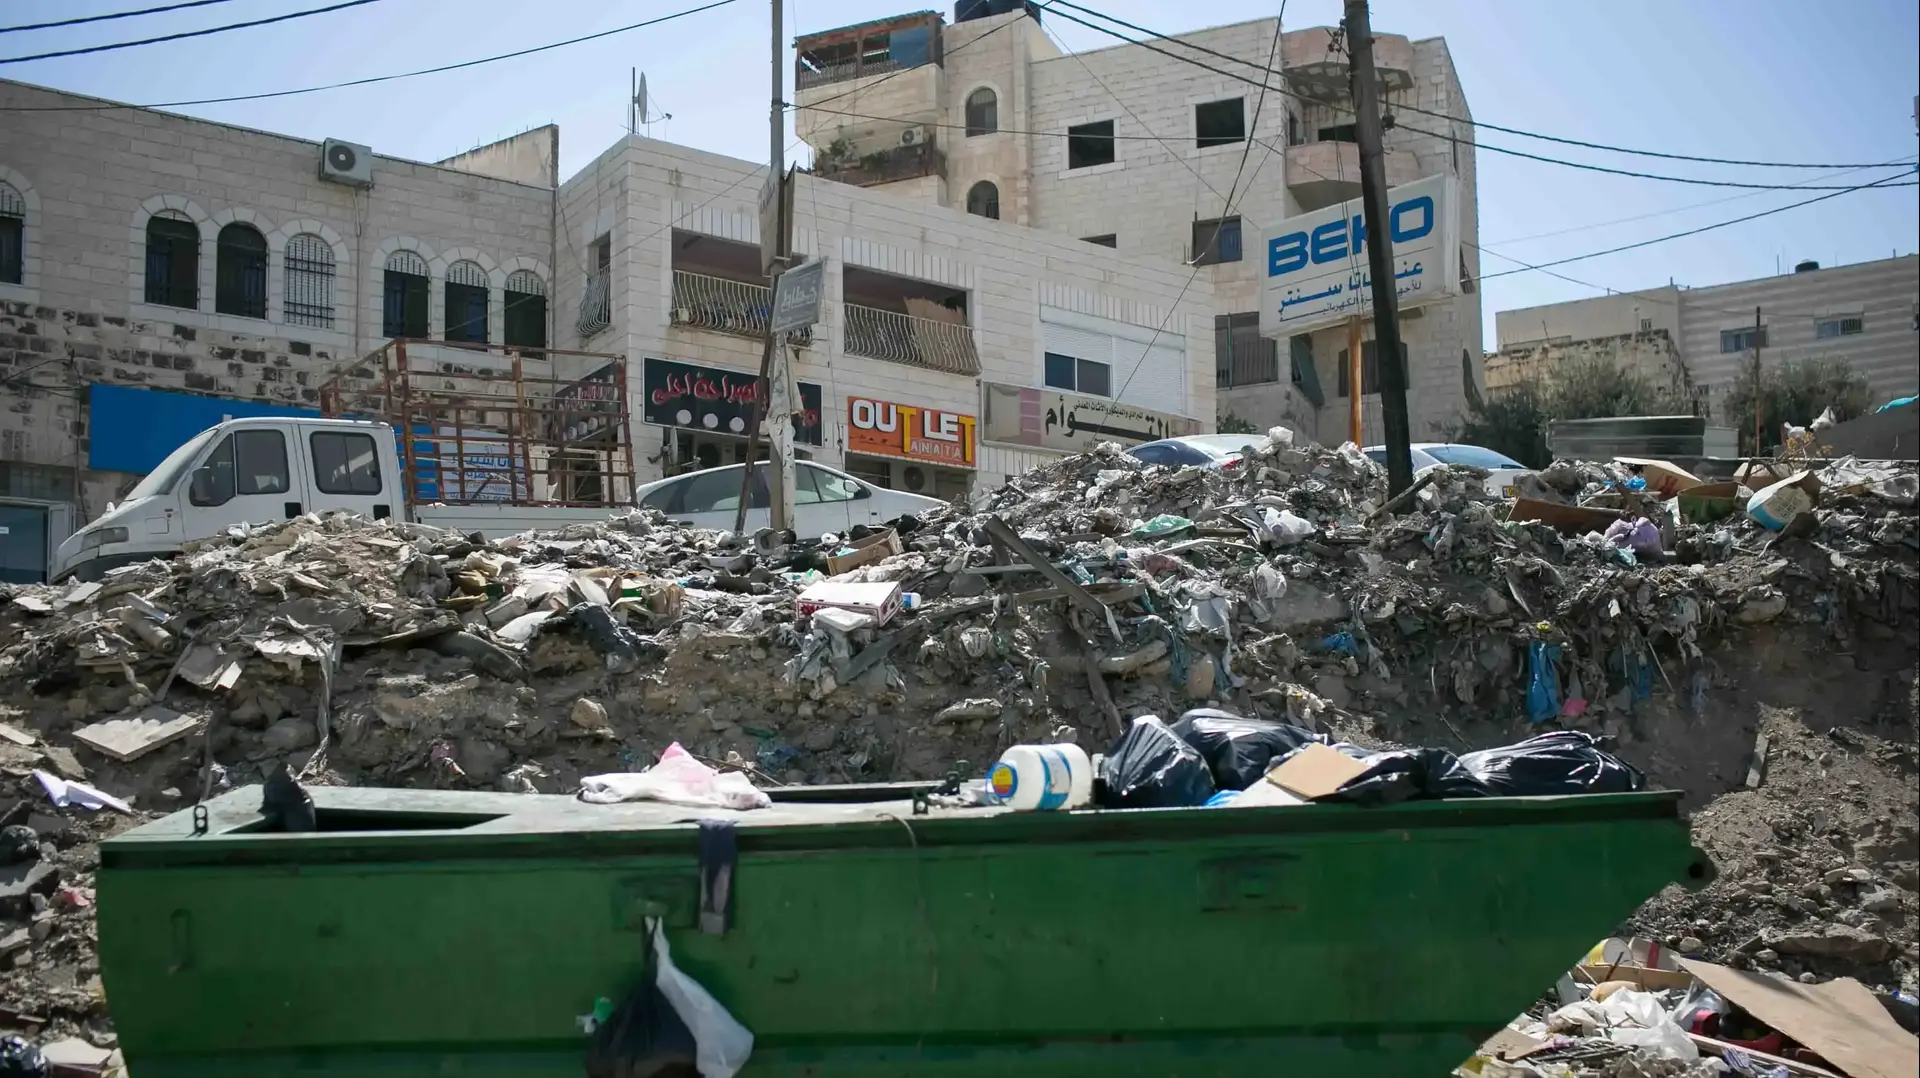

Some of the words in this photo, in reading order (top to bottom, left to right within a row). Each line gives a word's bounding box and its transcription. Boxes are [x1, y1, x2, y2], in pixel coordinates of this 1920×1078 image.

[1278, 282, 1343, 314] سنتر
[1044, 395, 1170, 441] التوأم
[911, 439, 962, 459] ANATA
